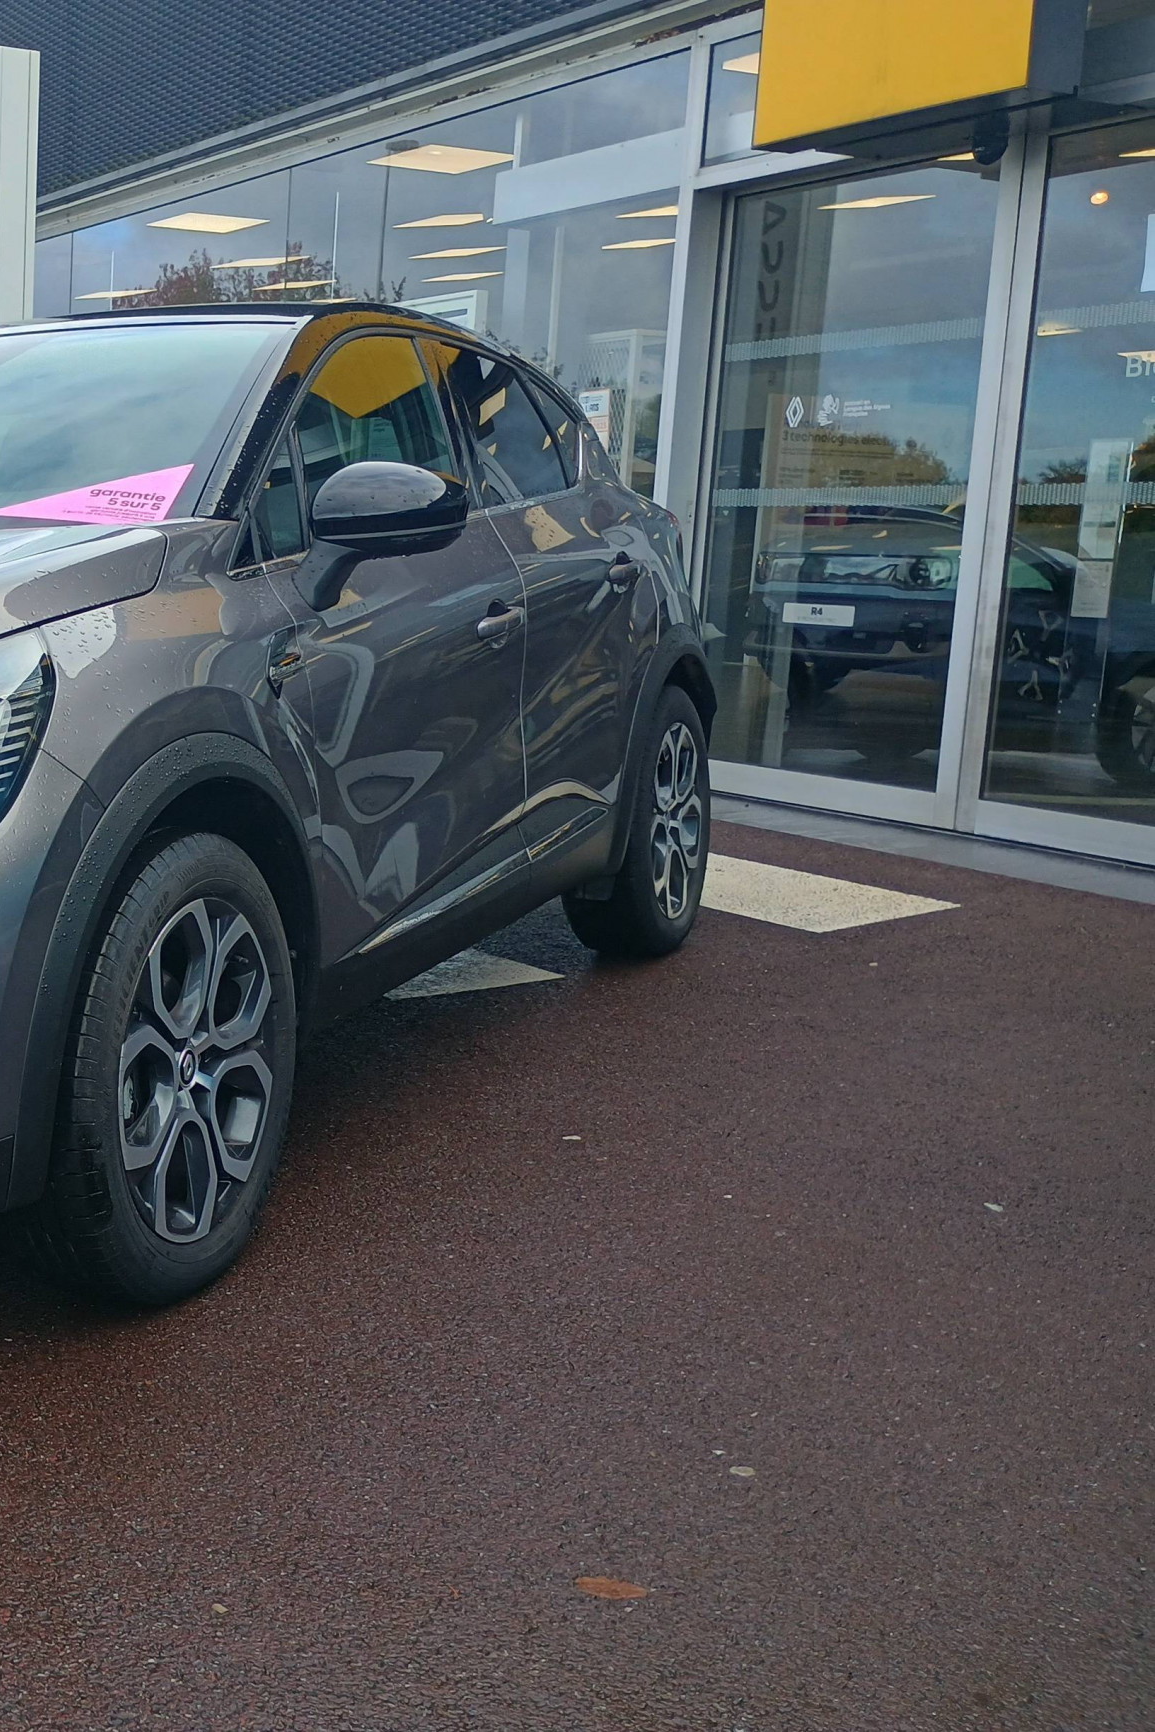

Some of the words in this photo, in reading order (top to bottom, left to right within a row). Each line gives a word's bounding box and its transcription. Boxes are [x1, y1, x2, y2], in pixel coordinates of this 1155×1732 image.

[90, 489, 166, 502] garantie
[107, 497, 119, 506] 5
[120, 500, 149, 509] sur
[150, 502, 163, 511] 5
[811, 606, 823, 616] R4
